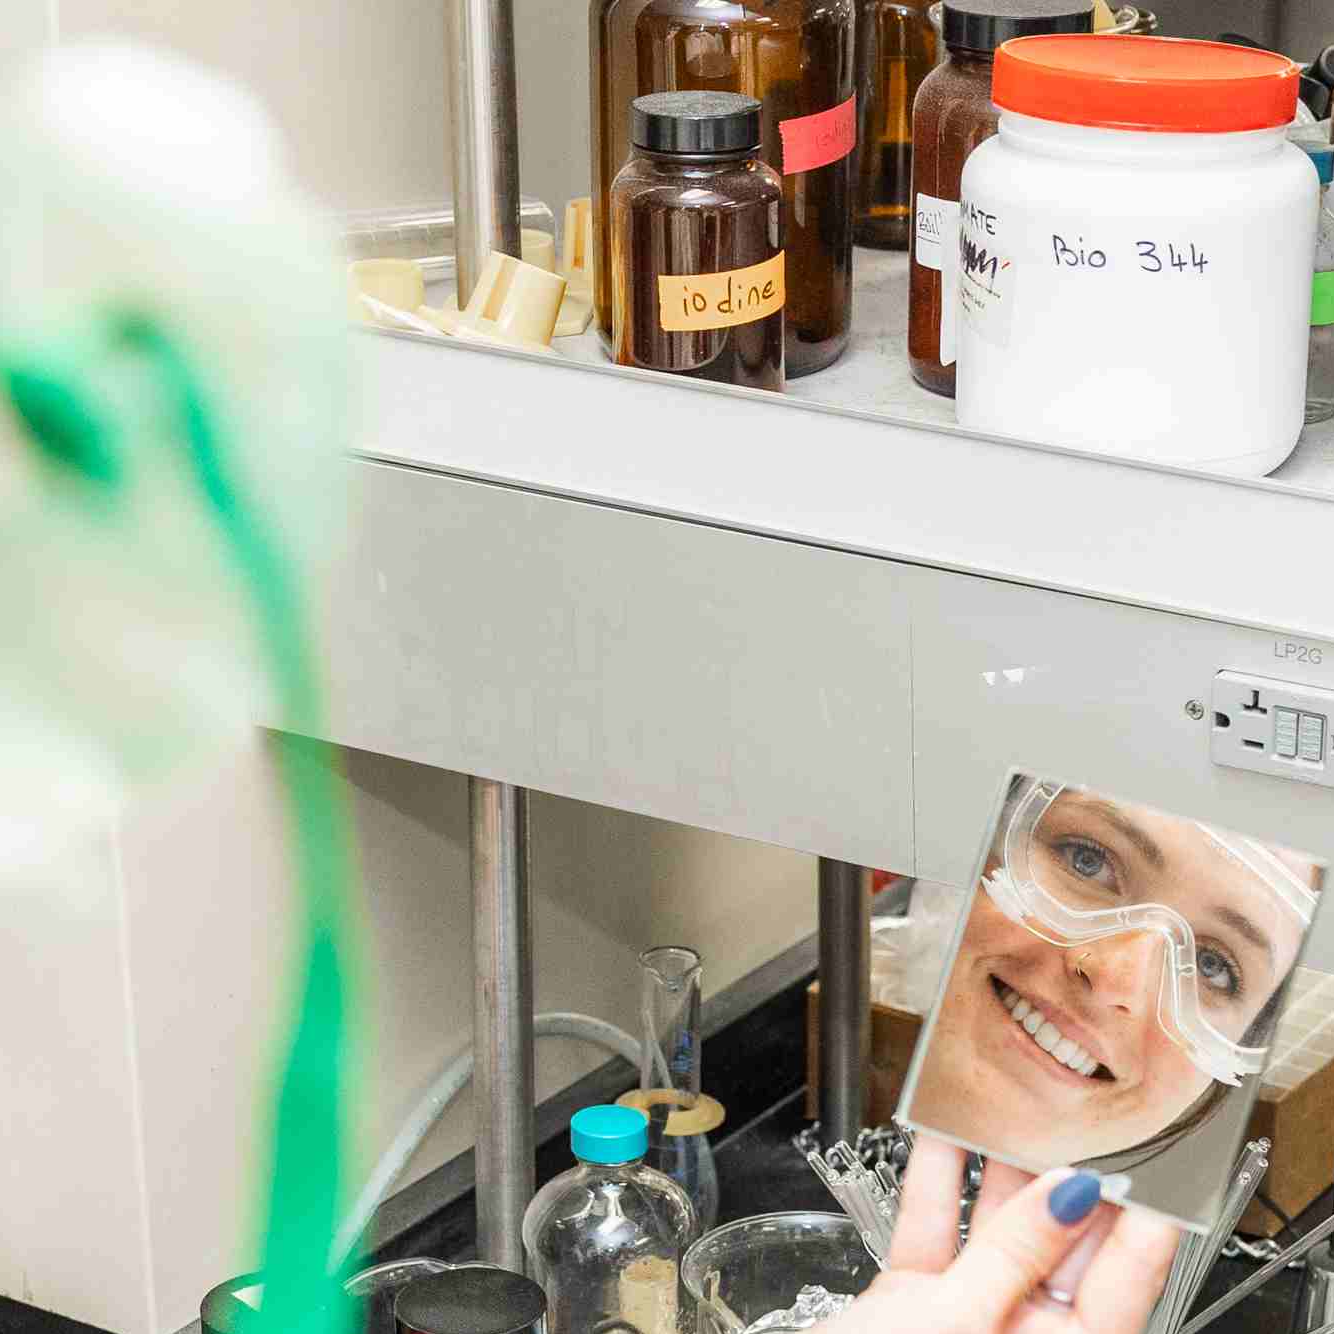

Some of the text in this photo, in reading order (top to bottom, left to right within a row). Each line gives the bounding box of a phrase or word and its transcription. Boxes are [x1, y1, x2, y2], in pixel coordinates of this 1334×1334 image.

[1052, 234, 1209, 273] Bio 344
[682, 276, 776, 317] iodine
[1274, 640, 1323, 665] LP2G
